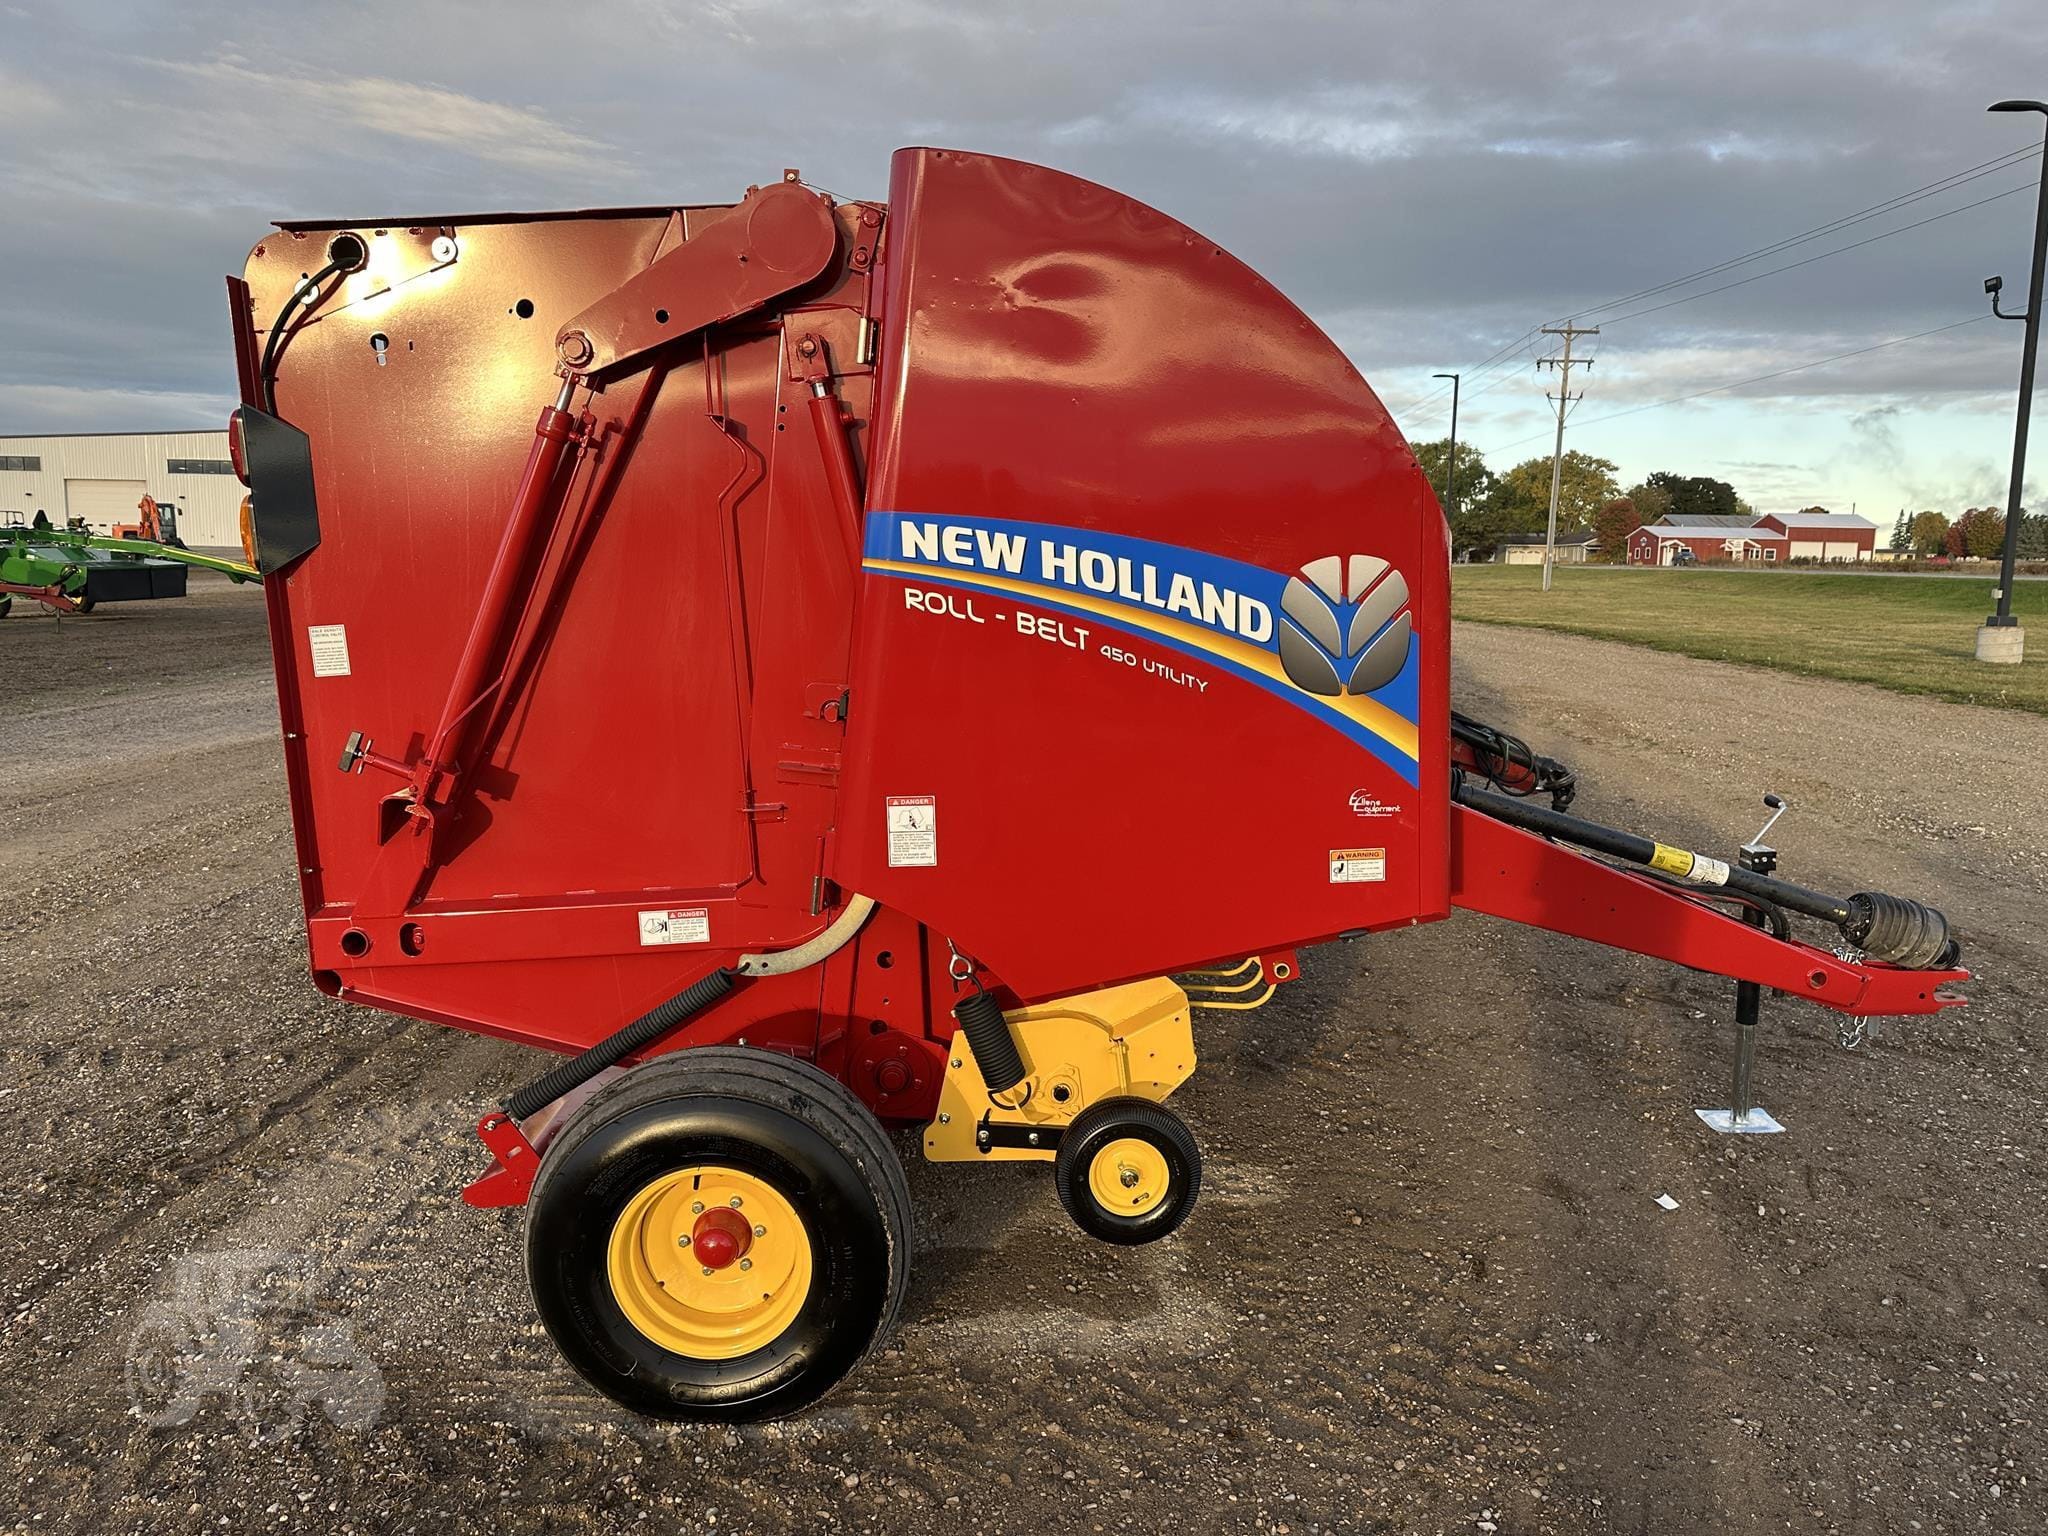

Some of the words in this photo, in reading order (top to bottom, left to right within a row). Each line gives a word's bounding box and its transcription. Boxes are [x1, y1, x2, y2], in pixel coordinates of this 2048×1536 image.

[900, 520, 1028, 574] NEW
[1041, 540, 1274, 643] HOLLAND
[904, 587, 985, 624] ROLL
[1016, 611, 1089, 650] BELT
[1100, 644, 1137, 667] 450
[1143, 658, 1208, 693] UTILITY
[1353, 794, 1401, 813] Equipment
[1346, 851, 1380, 859] WARNING
